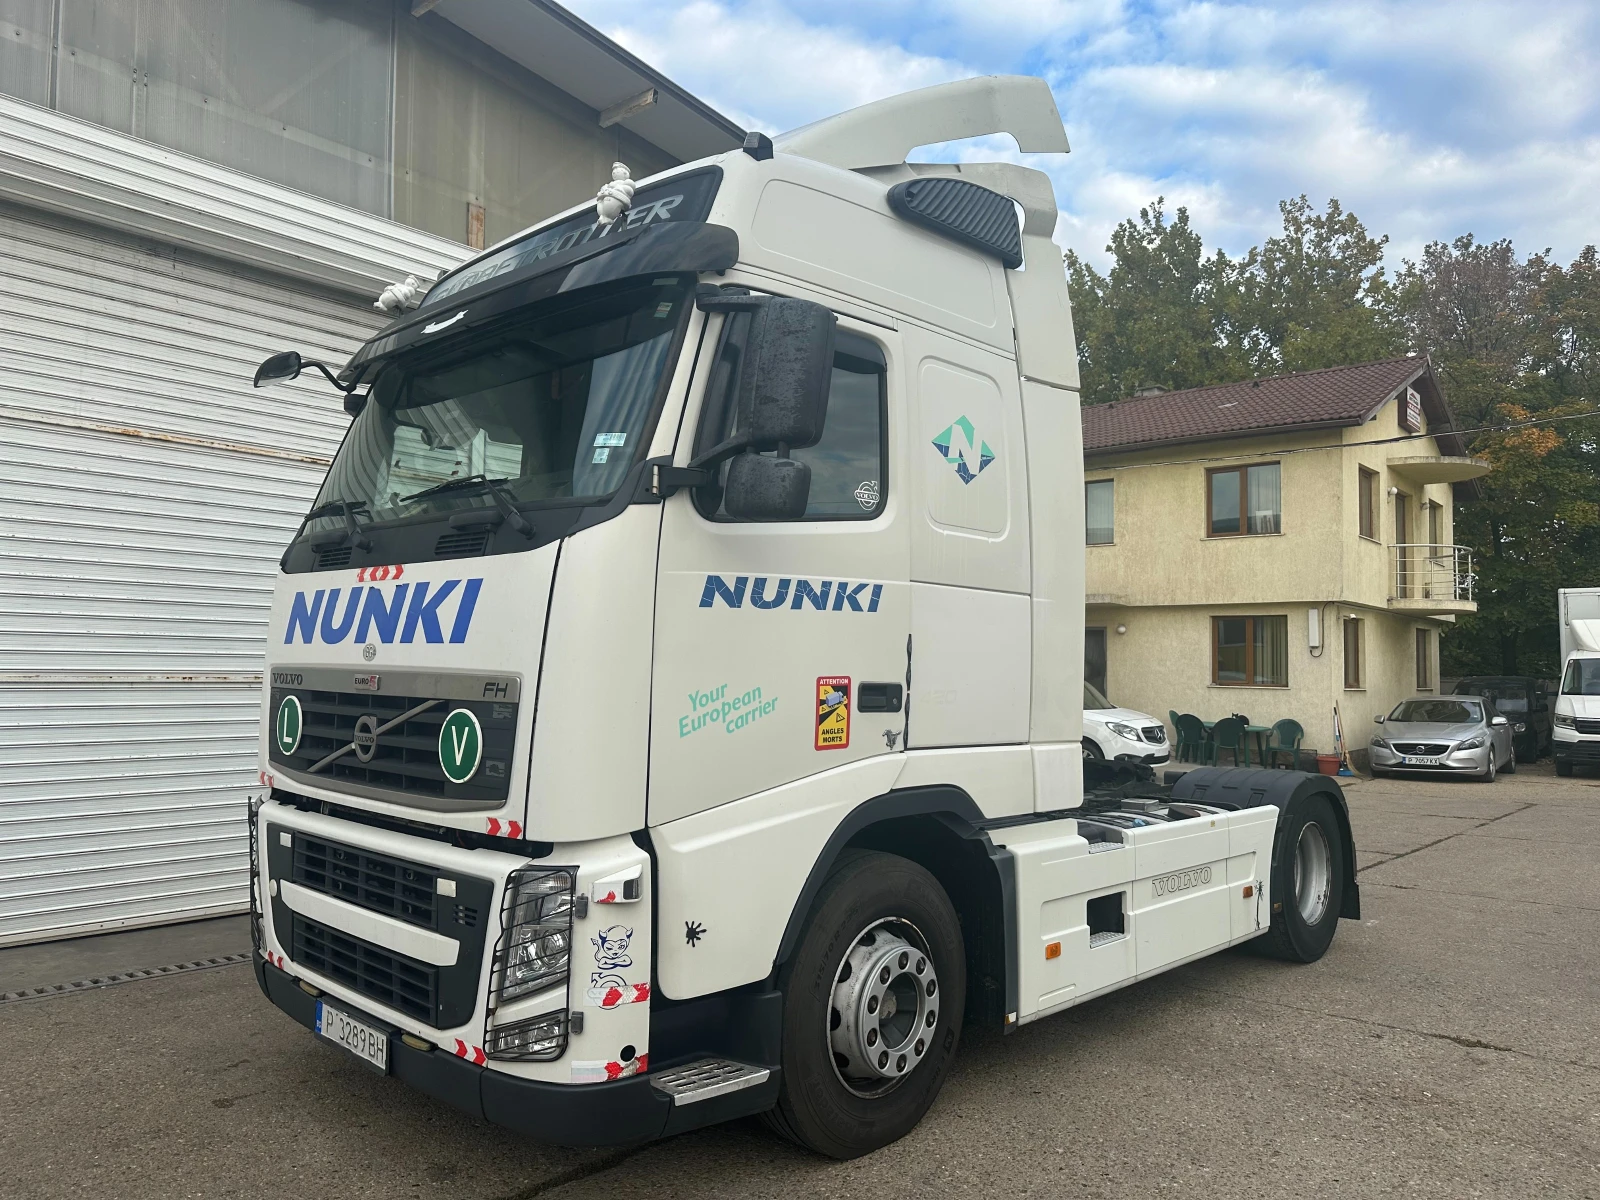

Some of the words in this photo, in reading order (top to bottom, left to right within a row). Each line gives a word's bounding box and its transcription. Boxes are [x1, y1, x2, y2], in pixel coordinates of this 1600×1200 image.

[856, 492, 879, 501] VOLVO
[698, 575, 884, 613] NUNKI
[284, 578, 484, 645] NUNKI
[272, 673, 303, 686] VOLVO
[370, 675, 377, 690] 5
[482, 682, 509, 698] FH
[679, 686, 762, 739] European
[687, 683, 728, 712] Your
[282, 707, 293, 744] L
[725, 697, 779, 734] carrier
[354, 734, 375, 744] VOLVO
[451, 725, 469, 766] V
[821, 727, 845, 736] ANGLES
[822, 735, 843, 744] MORTS
[1152, 866, 1212, 897] VOLVO
[338, 1017, 367, 1053] 3289
[368, 1031, 385, 1065] BH
